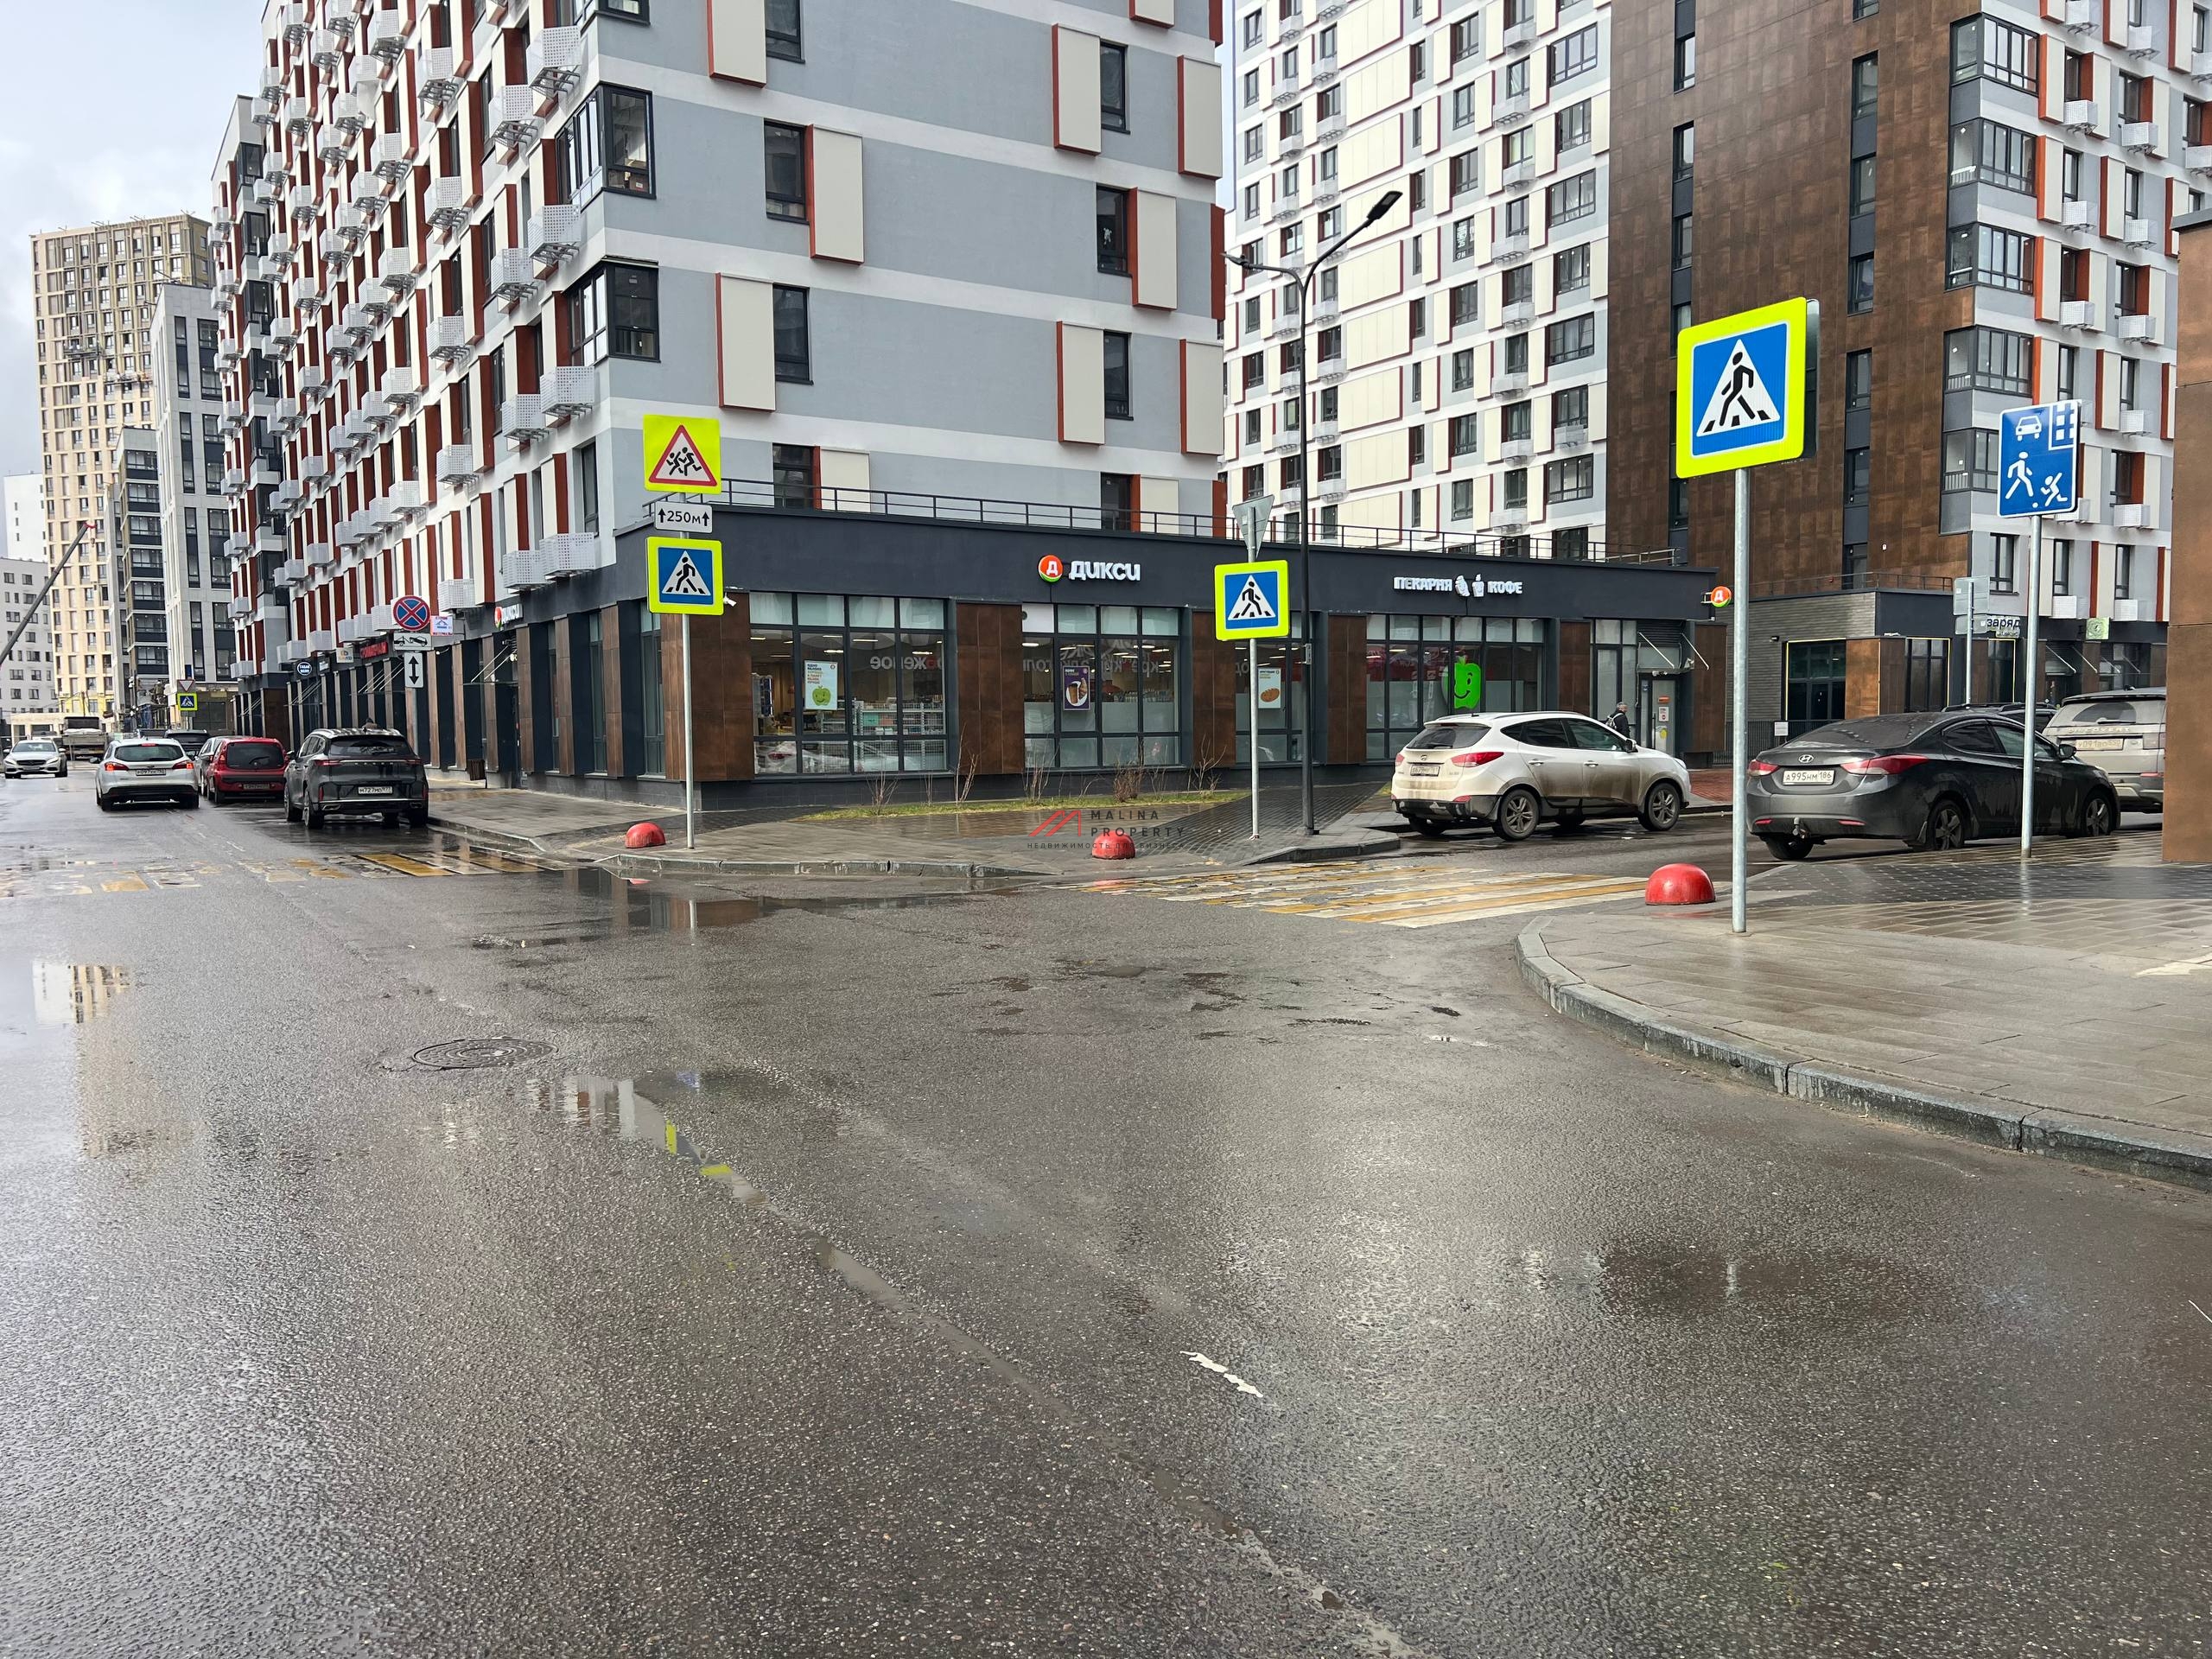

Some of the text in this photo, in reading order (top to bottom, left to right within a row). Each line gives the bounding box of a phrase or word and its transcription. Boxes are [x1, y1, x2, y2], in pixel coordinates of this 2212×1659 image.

[1394, 577, 1522, 594] ПЕКАРНЯ КОФЕ
[1987, 618, 2020, 630] заряд
